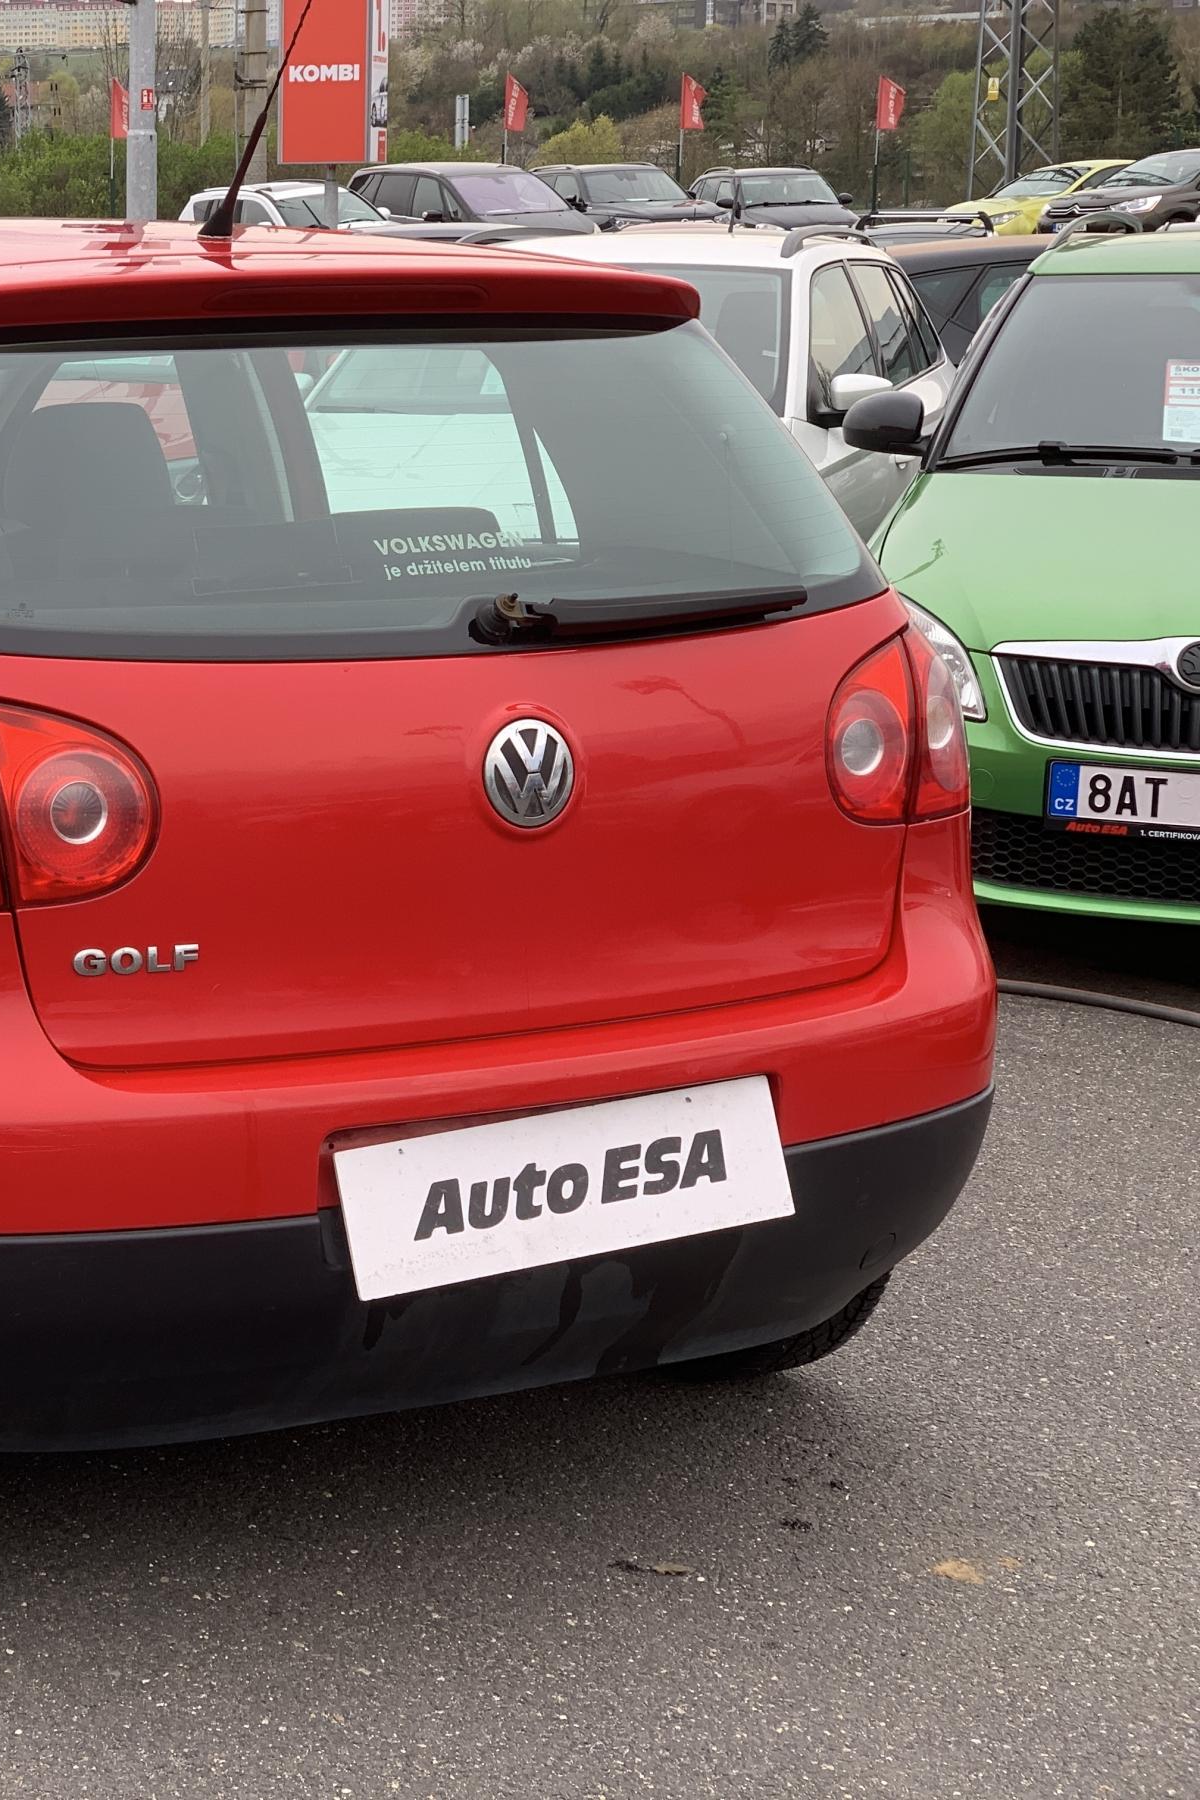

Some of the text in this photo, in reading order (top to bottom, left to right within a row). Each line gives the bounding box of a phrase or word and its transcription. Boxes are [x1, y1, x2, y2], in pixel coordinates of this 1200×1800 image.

[289, 63, 360, 82] KOMBI
[373, 531, 524, 556] VOLKSWAGEN
[383, 556, 532, 580] je držitelem titulu
[1054, 798, 1074, 811] CZ
[1088, 773, 1168, 818] 8AT
[1065, 821, 1128, 836] Auto ESA
[1140, 829, 1147, 837] 1.
[73, 943, 199, 976] GOLF
[414, 1129, 727, 1241] Auto ESA
